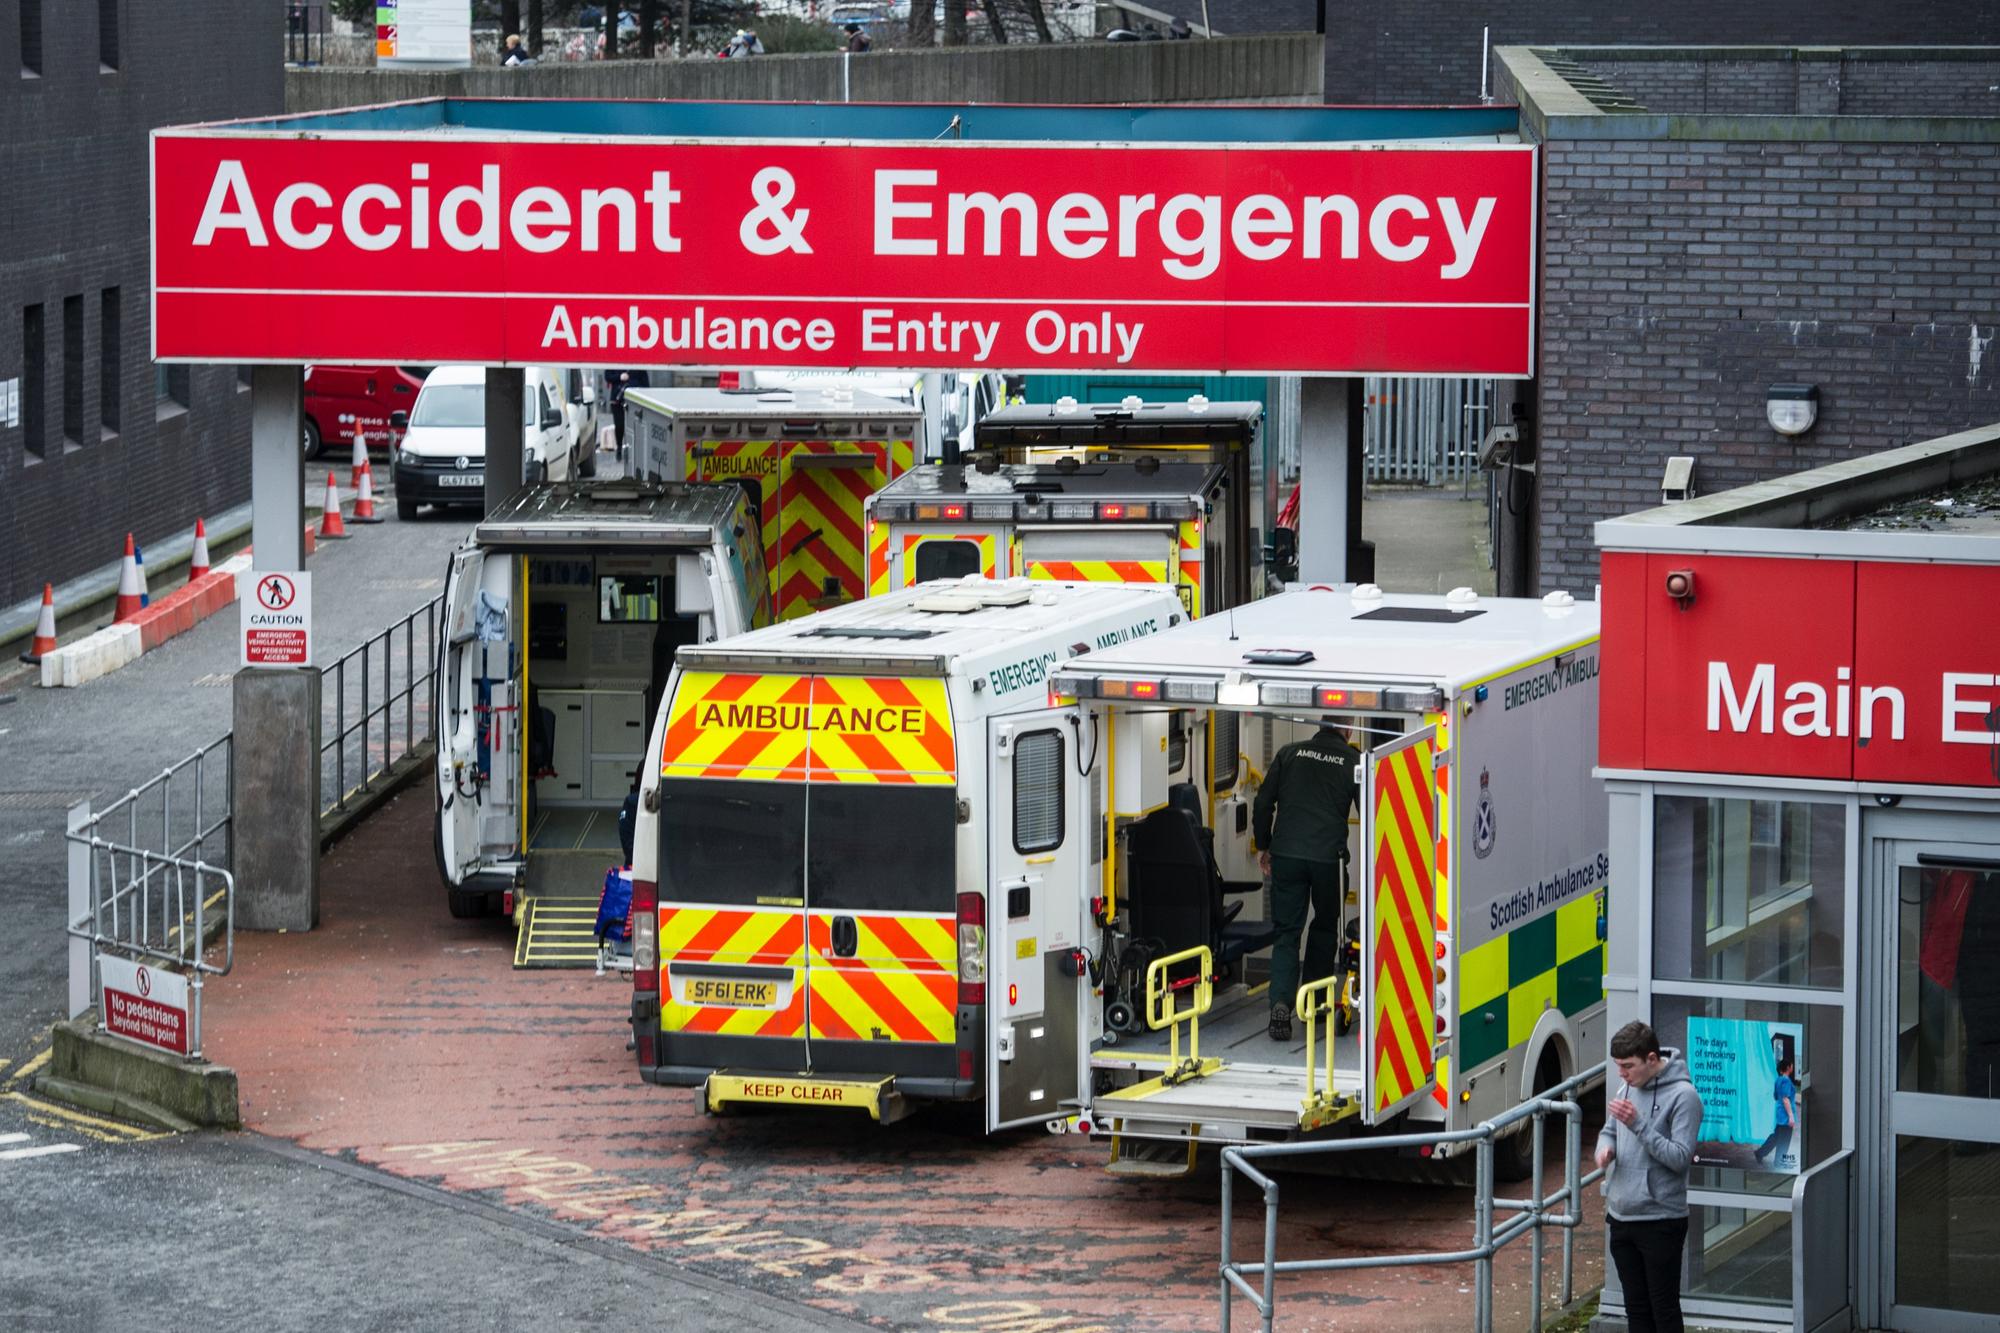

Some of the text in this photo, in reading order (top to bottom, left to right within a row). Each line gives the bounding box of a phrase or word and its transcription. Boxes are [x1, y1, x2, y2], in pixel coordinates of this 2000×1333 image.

[387, 26, 397, 40] 2
[389, 42, 397, 57] 1
[193, 160, 1497, 281] Accident & Emergency
[541, 305, 1144, 363] Ambulance Entry Only
[703, 456, 778, 474] AMBULANCE
[250, 614, 303, 625] CAUTION
[248, 638, 305, 647] VEHICLE ACTIVITY
[256, 631, 297, 639] EMERGENCY
[251, 646, 302, 655] NO PEDESTRIAN
[1505, 666, 1564, 711] EMERGENCY
[1707, 661, 2000, 744] Main E
[700, 703, 922, 733] AMBULANCE
[1296, 749, 1345, 766] AMBULANCE
[1490, 886, 1535, 931] Scottish
[1537, 863, 1594, 910] Ambulance
[694, 981, 767, 1001] SF61 ERK
[112, 994, 179, 1028] No pedestrians
[113, 1013, 177, 1044] beyond this point
[1695, 1036, 1728, 1049] The days
[1694, 1049, 1736, 1062] of smoking
[1694, 1061, 1723, 1071] on NHS
[1694, 1073, 1725, 1084] grounds
[743, 1083, 843, 1101] KEEP CLEAR
[1713, 1085, 1737, 1097] drawn
[1703, 1099, 1708, 1107] a
[1781, 1153, 1796, 1161] NHS
